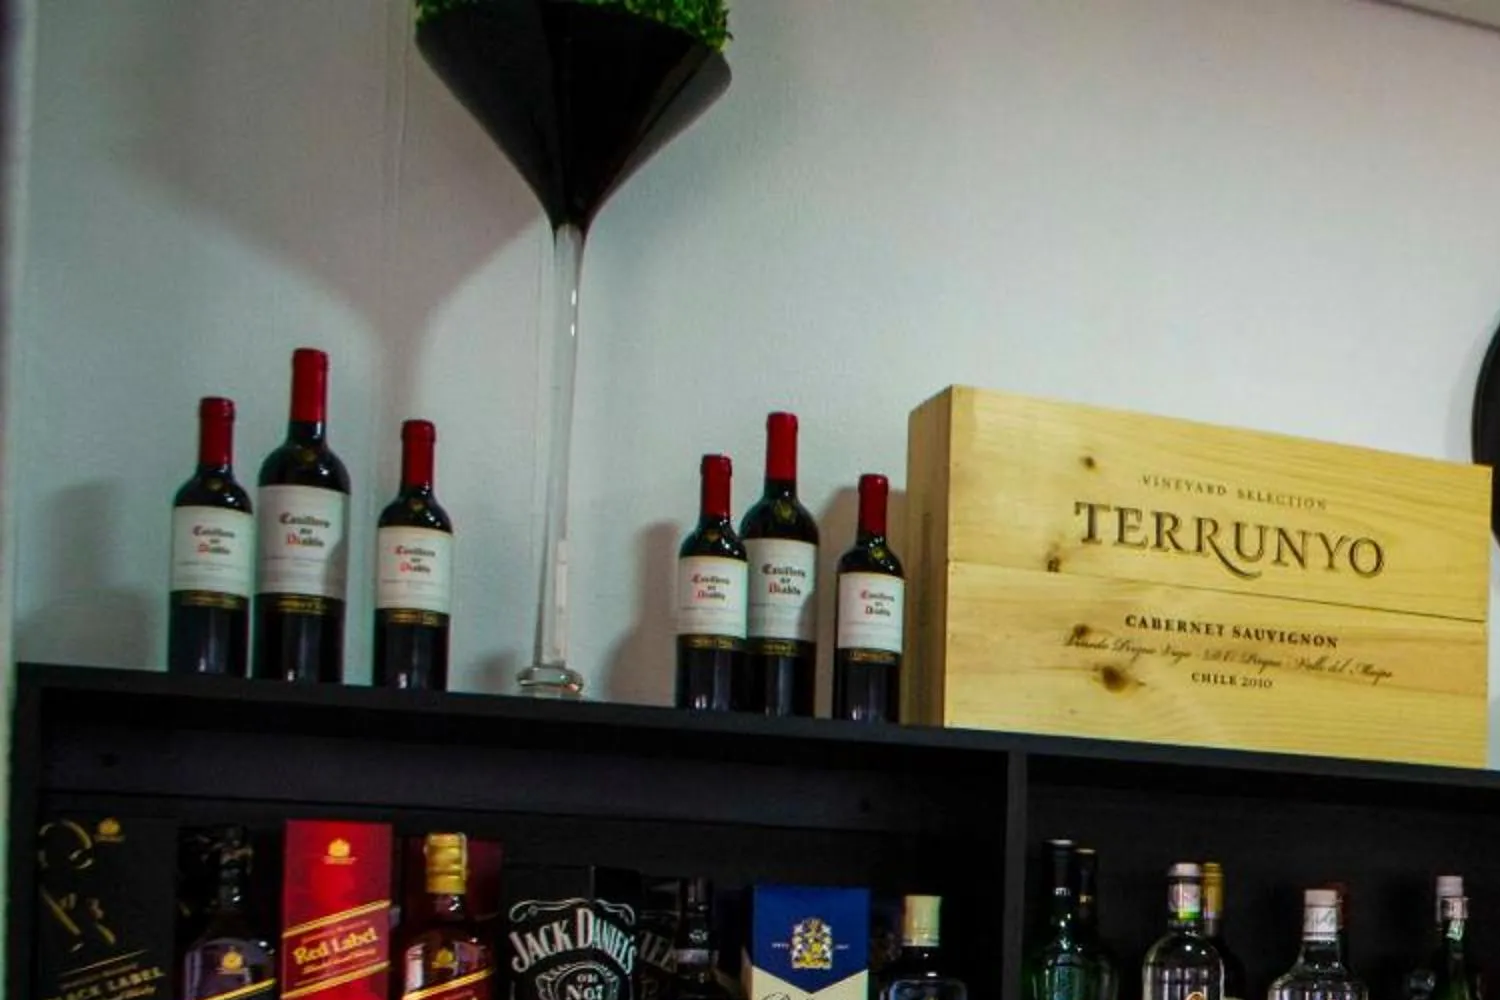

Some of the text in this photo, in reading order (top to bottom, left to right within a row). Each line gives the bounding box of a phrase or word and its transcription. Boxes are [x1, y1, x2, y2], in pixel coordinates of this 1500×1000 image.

[1142, 475, 1327, 510] VINEYARD SELECTION
[1074, 501, 1385, 580] TERRUNYO
[1125, 614, 1338, 648] CABERNET SAUVIGNON
[1191, 671, 1237, 687] CHILE
[293, 927, 378, 965] Red Label
[509, 920, 573, 973] JACK
[576, 908, 637, 975] DANIEL'S
[106, 966, 165, 991] LABEL
